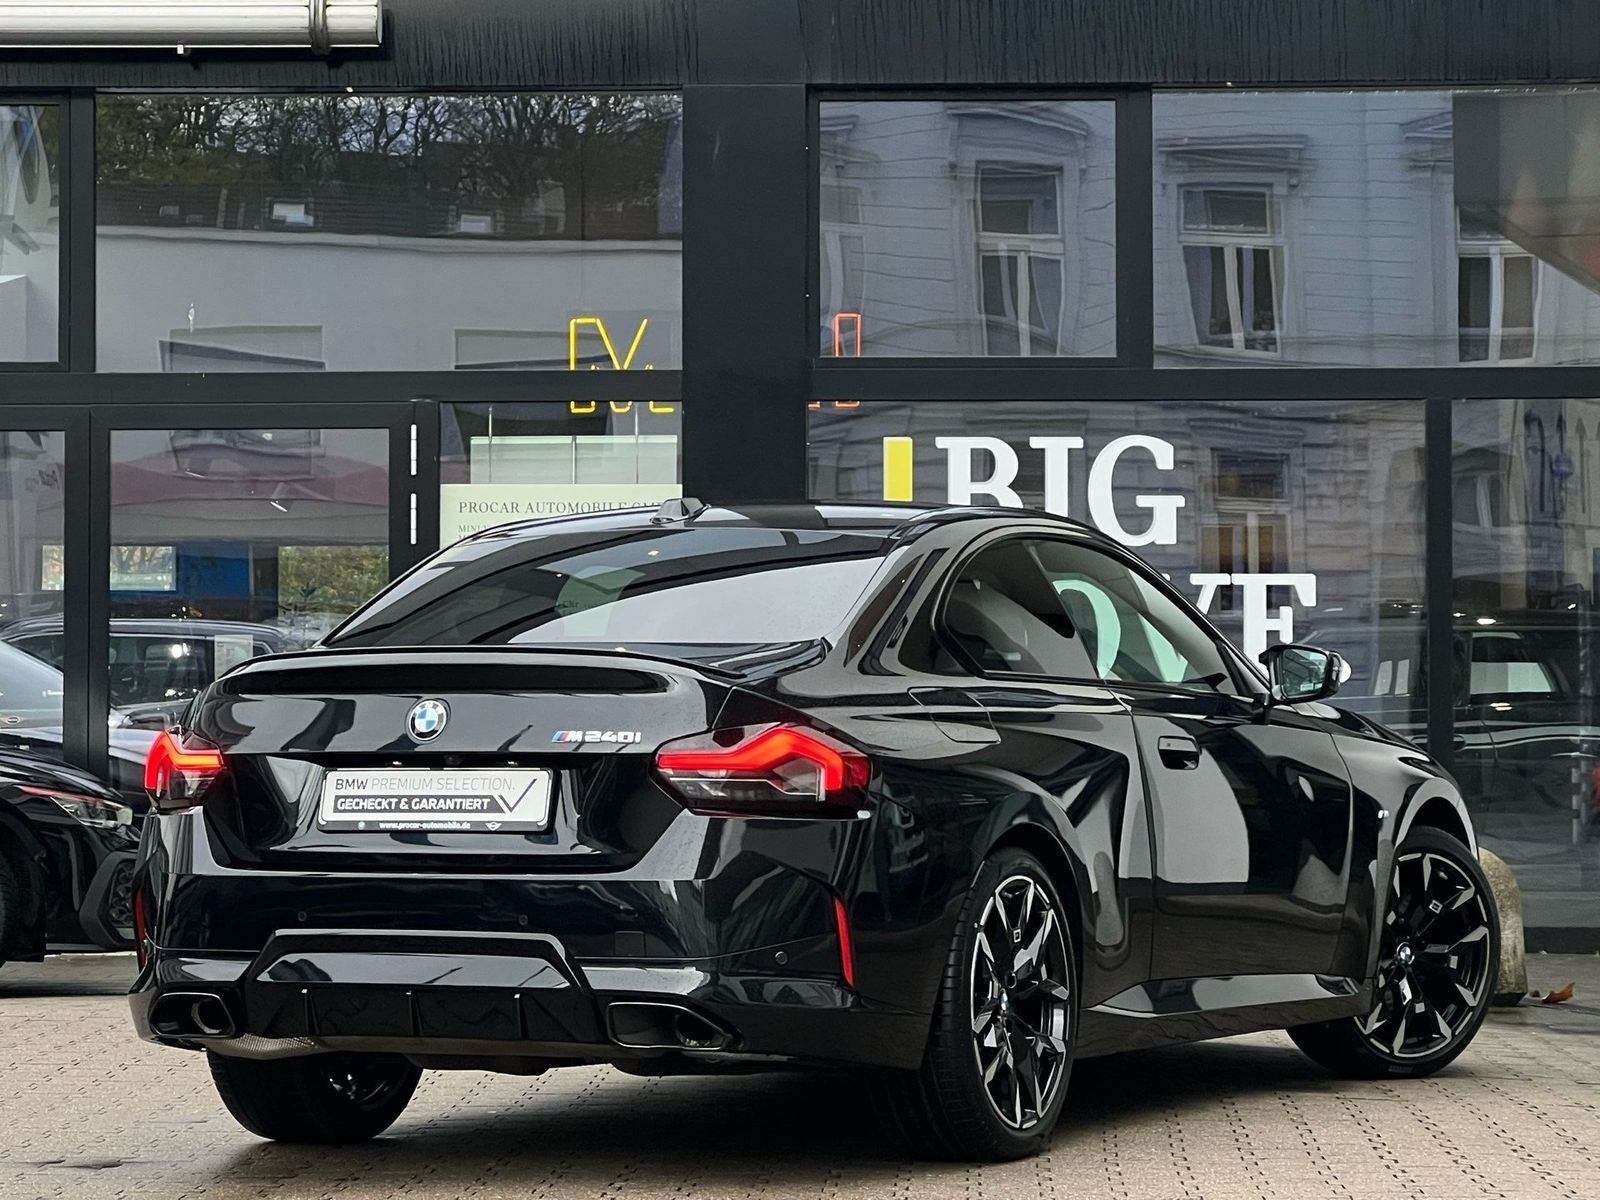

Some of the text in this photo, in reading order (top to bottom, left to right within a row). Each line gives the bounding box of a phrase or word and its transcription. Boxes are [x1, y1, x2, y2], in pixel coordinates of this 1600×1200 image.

[934, 434, 1186, 547] BIG
[458, 501, 520, 513] PROCAR
[335, 778, 369, 790] BMW
[371, 777, 433, 791] PREMIUM
[336, 797, 491, 810] GECHECKT & GARANTIERT
[379, 821, 471, 830] www.procar-automobile.de
